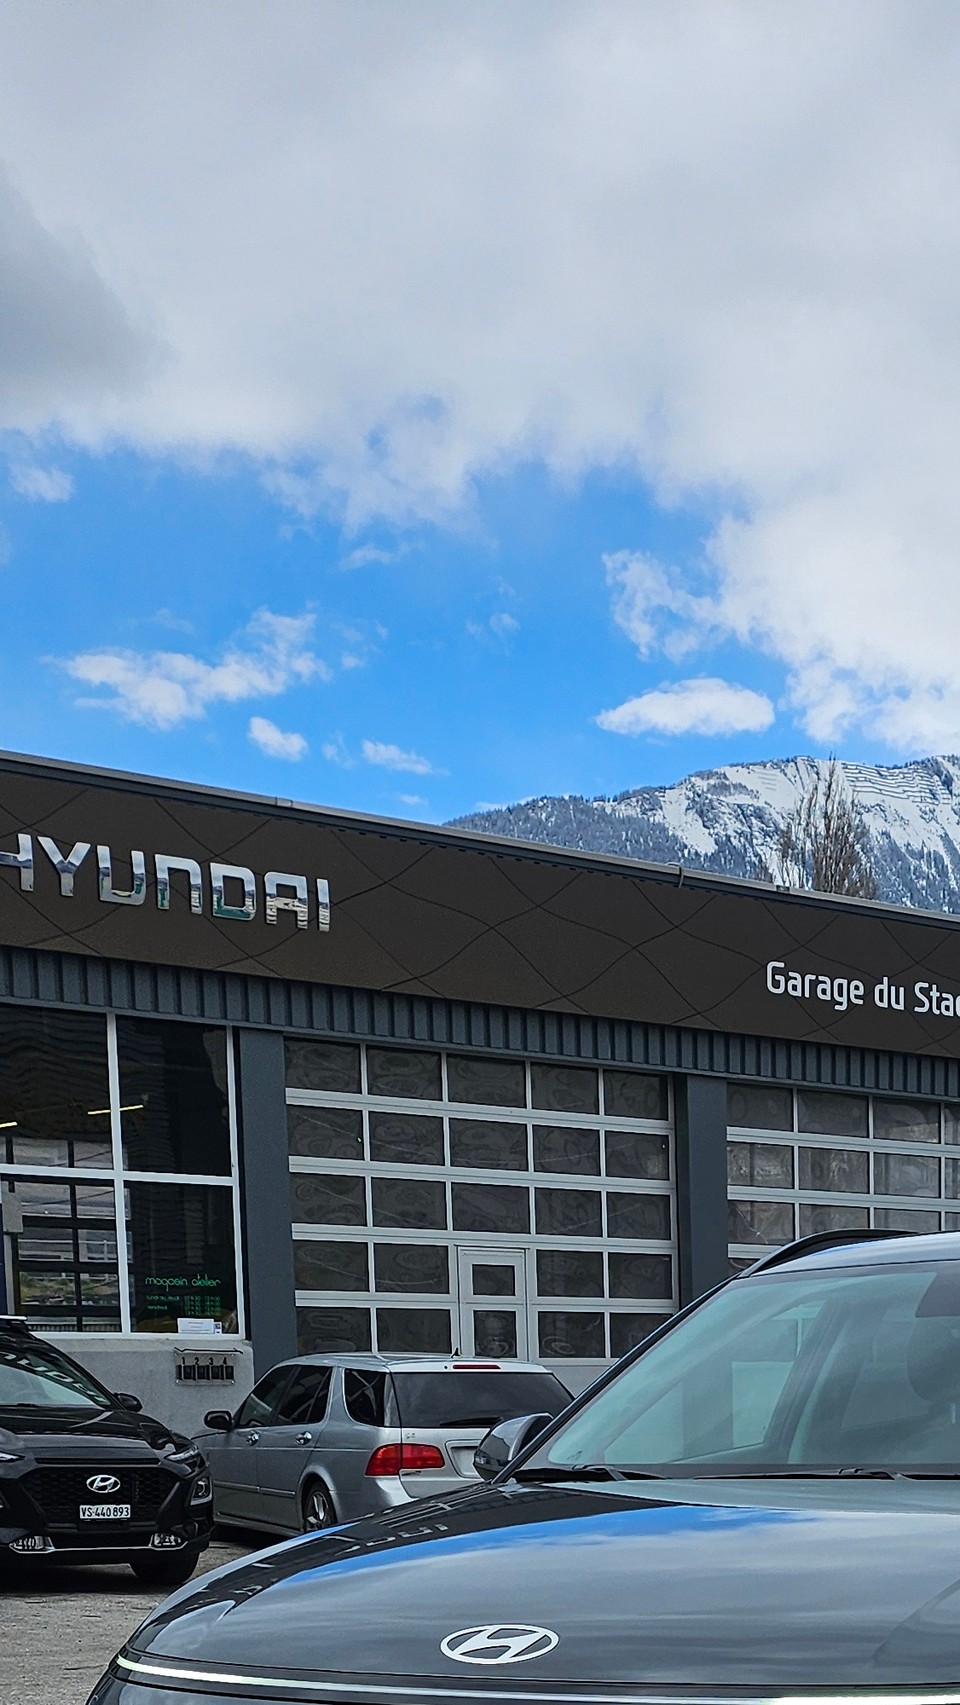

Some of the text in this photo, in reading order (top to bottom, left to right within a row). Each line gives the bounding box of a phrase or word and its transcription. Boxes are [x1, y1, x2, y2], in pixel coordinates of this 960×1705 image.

[0, 833, 330, 933] HYUNDAI
[766, 960, 865, 1011] Garage
[874, 976, 905, 1011] du
[181, 1356, 228, 1366] 1 2 3 4
